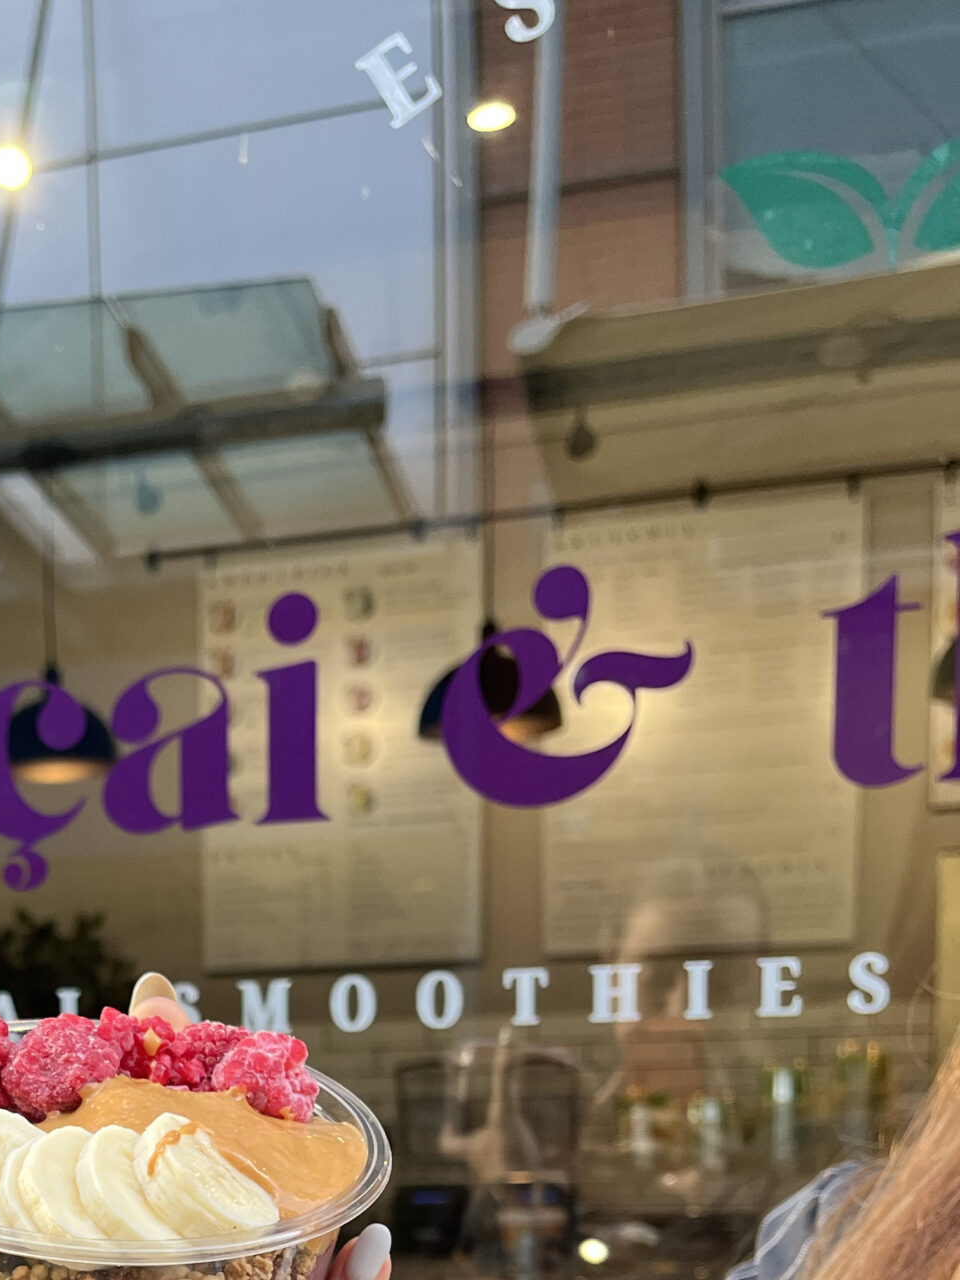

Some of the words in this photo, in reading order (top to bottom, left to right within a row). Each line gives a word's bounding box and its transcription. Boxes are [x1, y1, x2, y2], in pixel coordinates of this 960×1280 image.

[440, 564, 695, 810] &
[819, 533, 960, 789] t
[172, 951, 892, 1034] SMOOTHIES
